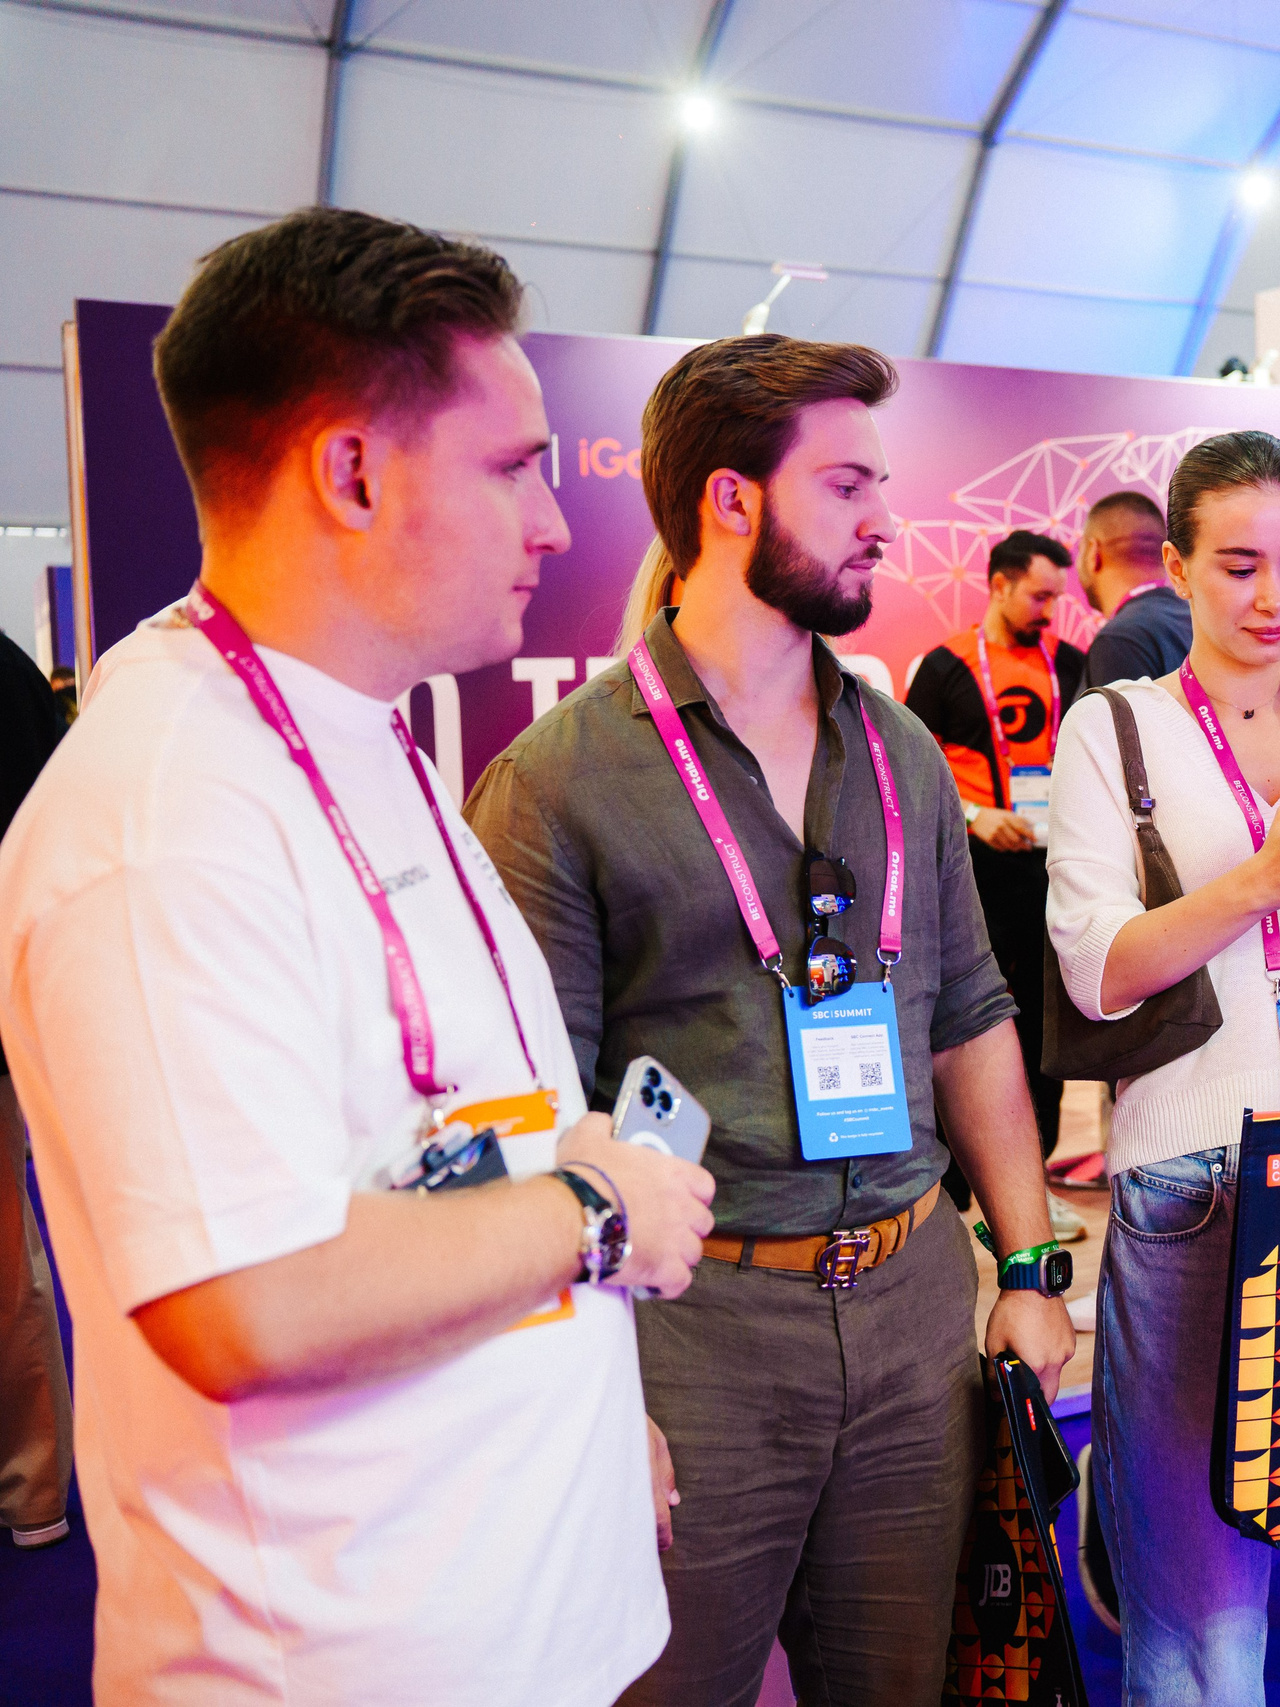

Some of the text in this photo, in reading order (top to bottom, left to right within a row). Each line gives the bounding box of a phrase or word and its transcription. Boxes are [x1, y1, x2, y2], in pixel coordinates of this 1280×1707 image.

[872, 742, 895, 810] BETCONSTRUCT
[1233, 780, 1263, 835] BETCONSTRUCT
[724, 843, 760, 921] BETCONSTRUCT
[812, 1008, 872, 1020] SBC SUMMIT
[979, 1564, 1012, 1607] JDB
